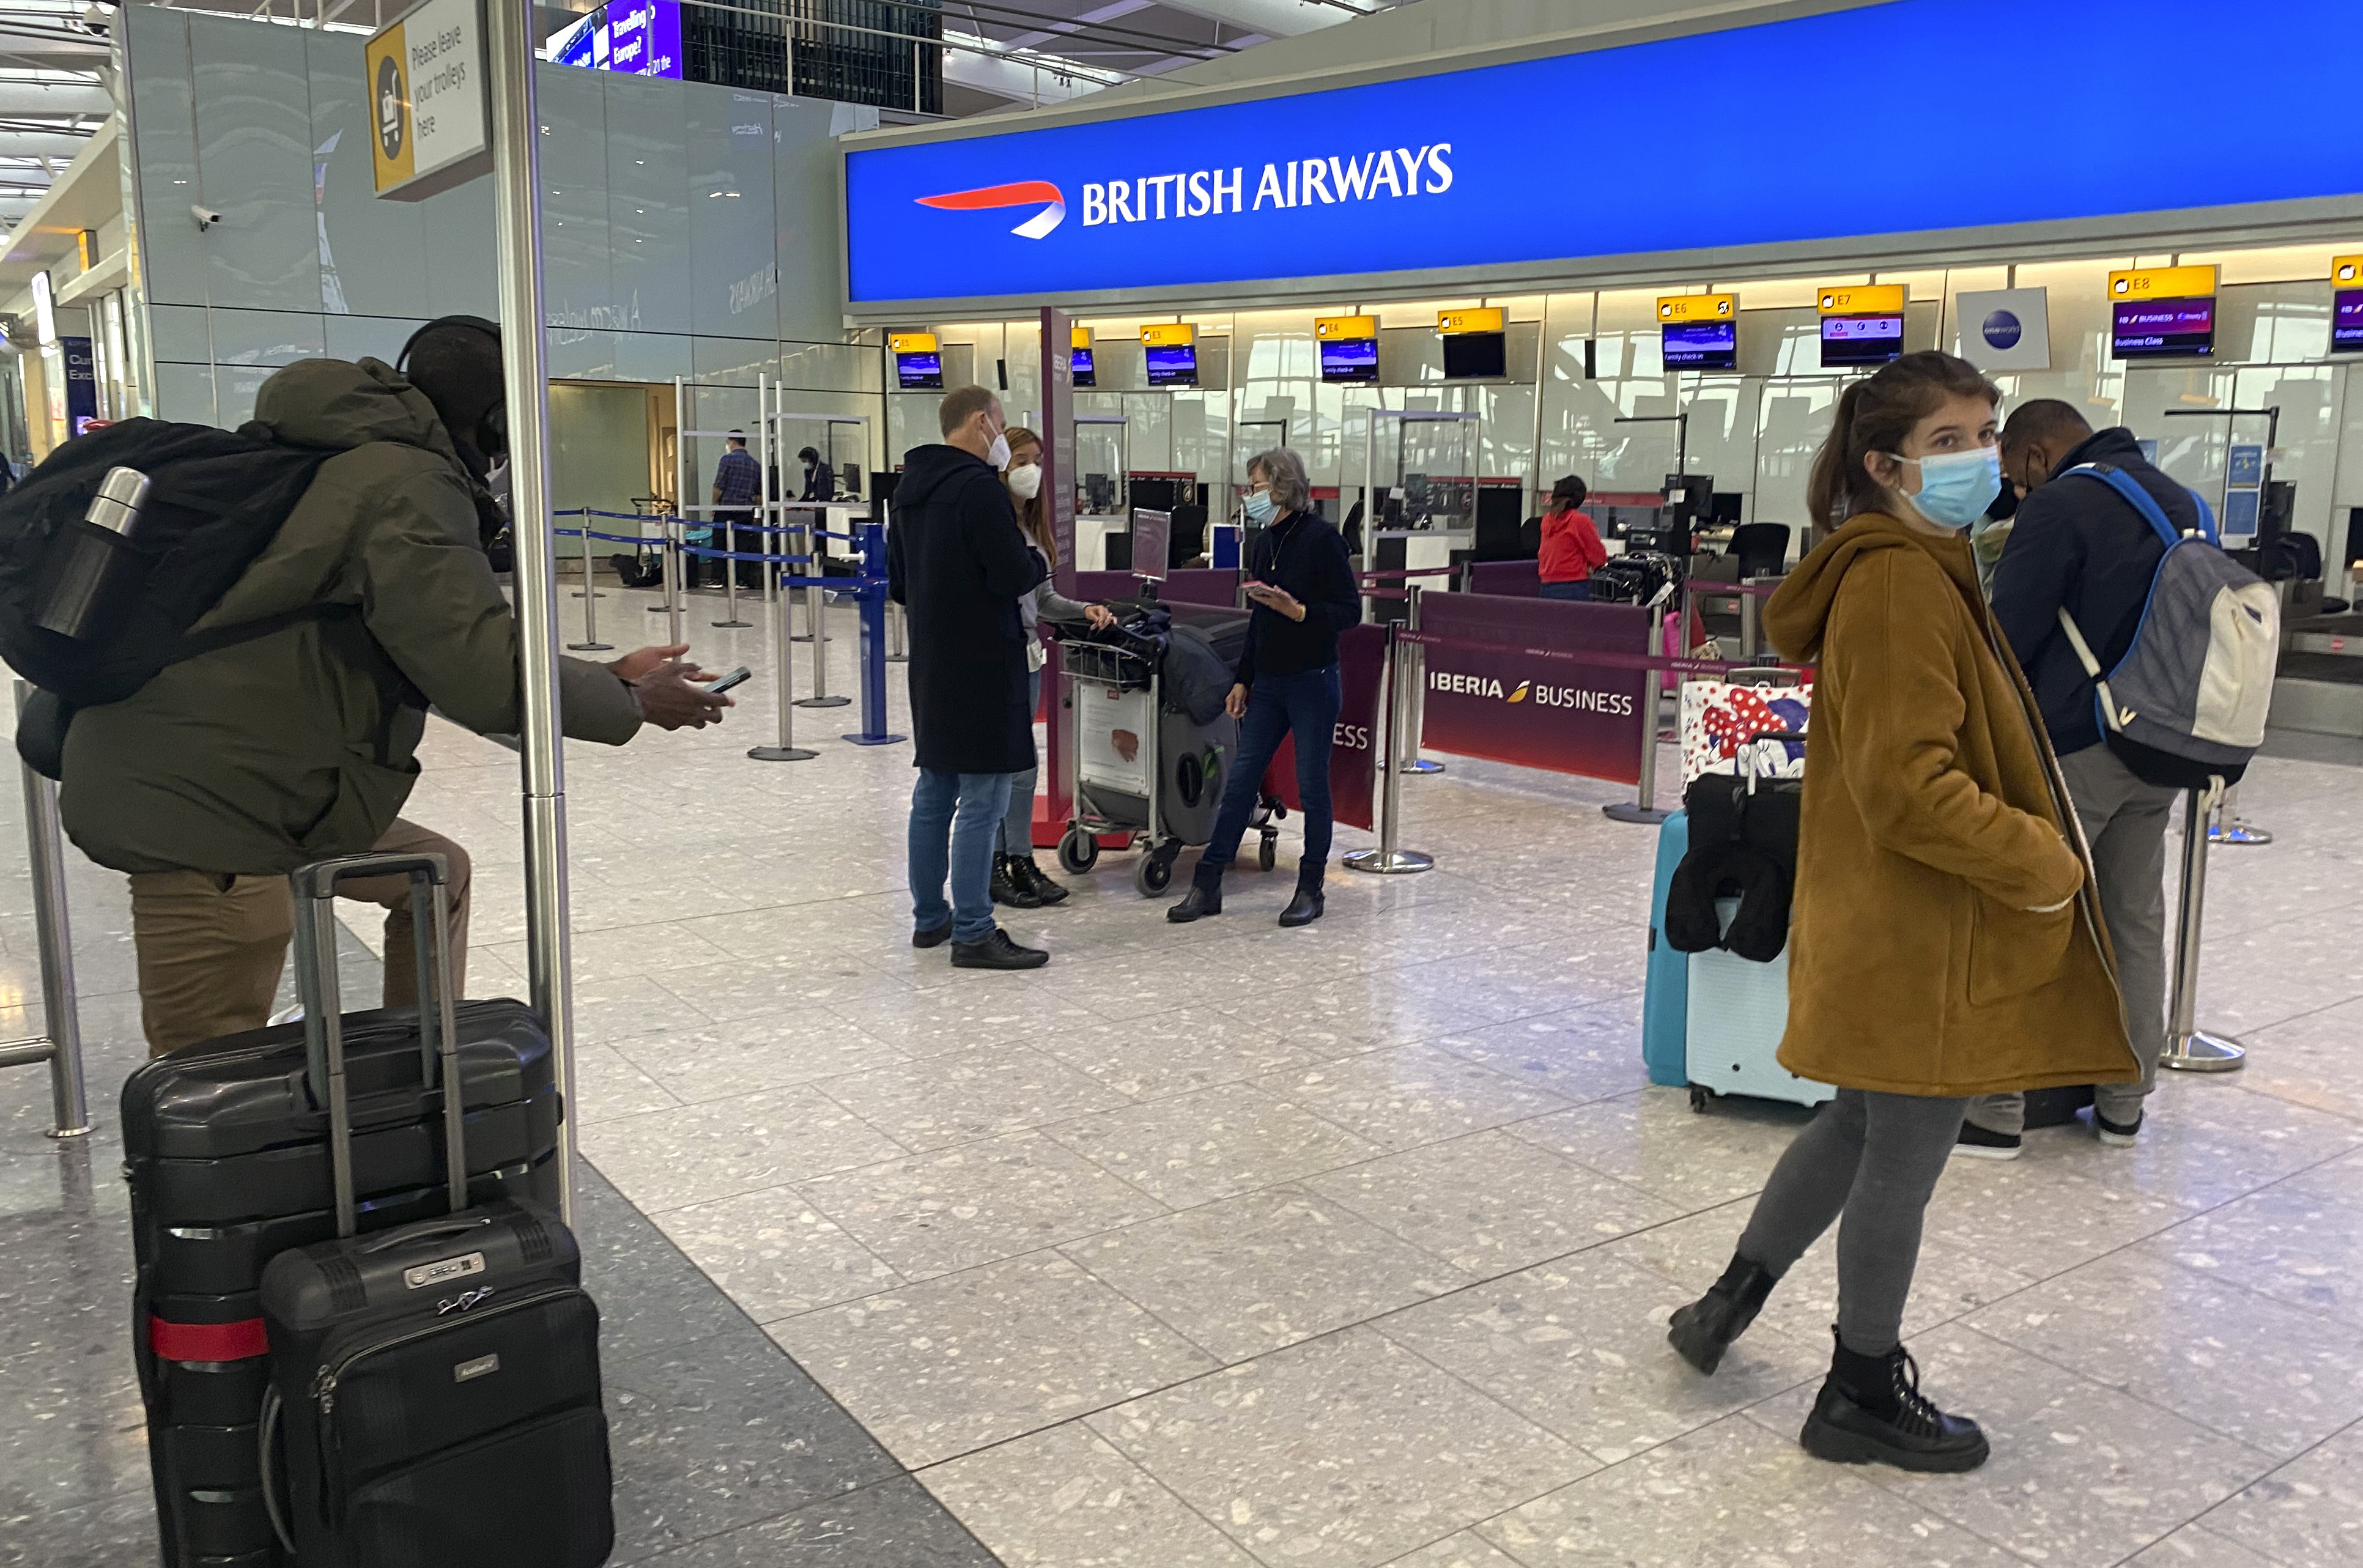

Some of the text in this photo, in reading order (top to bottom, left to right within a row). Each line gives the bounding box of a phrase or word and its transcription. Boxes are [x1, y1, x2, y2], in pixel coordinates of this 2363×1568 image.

[612, 9, 646, 39] Travelling
[412, 26, 462, 70] Please leave
[613, 35, 642, 64] Europe?
[413, 61, 466, 112] your trolleys
[417, 115, 435, 140] here
[1082, 142, 1454, 226] BRITISH AIRWAYS
[2133, 277, 2150, 290] E8
[1674, 303, 1687, 314] E6
[1838, 294, 1851, 305] E7
[1329, 323, 1339, 332] E4
[1453, 316, 1463, 326] E5
[2145, 336, 2164, 346] Class
[1429, 671, 1633, 716] IBERIA BUSINESS
